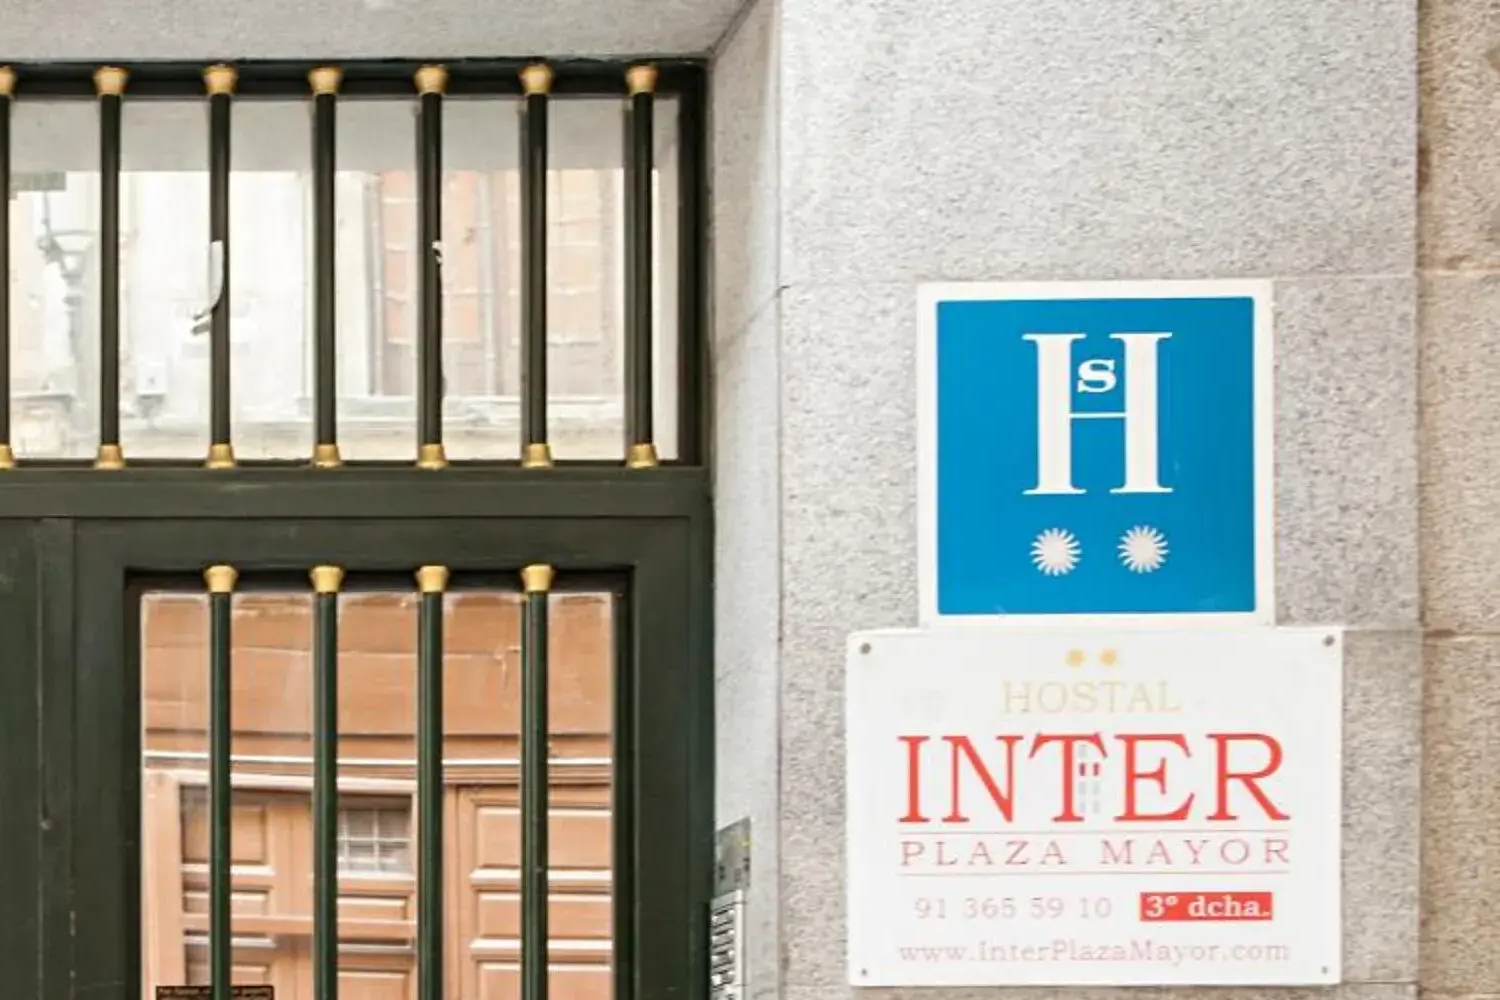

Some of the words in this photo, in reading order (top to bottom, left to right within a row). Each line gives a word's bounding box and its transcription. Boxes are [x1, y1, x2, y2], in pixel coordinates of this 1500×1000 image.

[1002, 680, 1183, 714] HOSTAL
[897, 732, 1291, 823] INTER
[900, 840, 1067, 866] PLAZA
[1100, 838, 1291, 865] MAYOR
[914, 897, 946, 919] 91
[962, 897, 1017, 919] 365
[1030, 897, 1064, 919] 59
[1079, 897, 1112, 919] 10
[1187, 894, 1271, 918] dcha.
